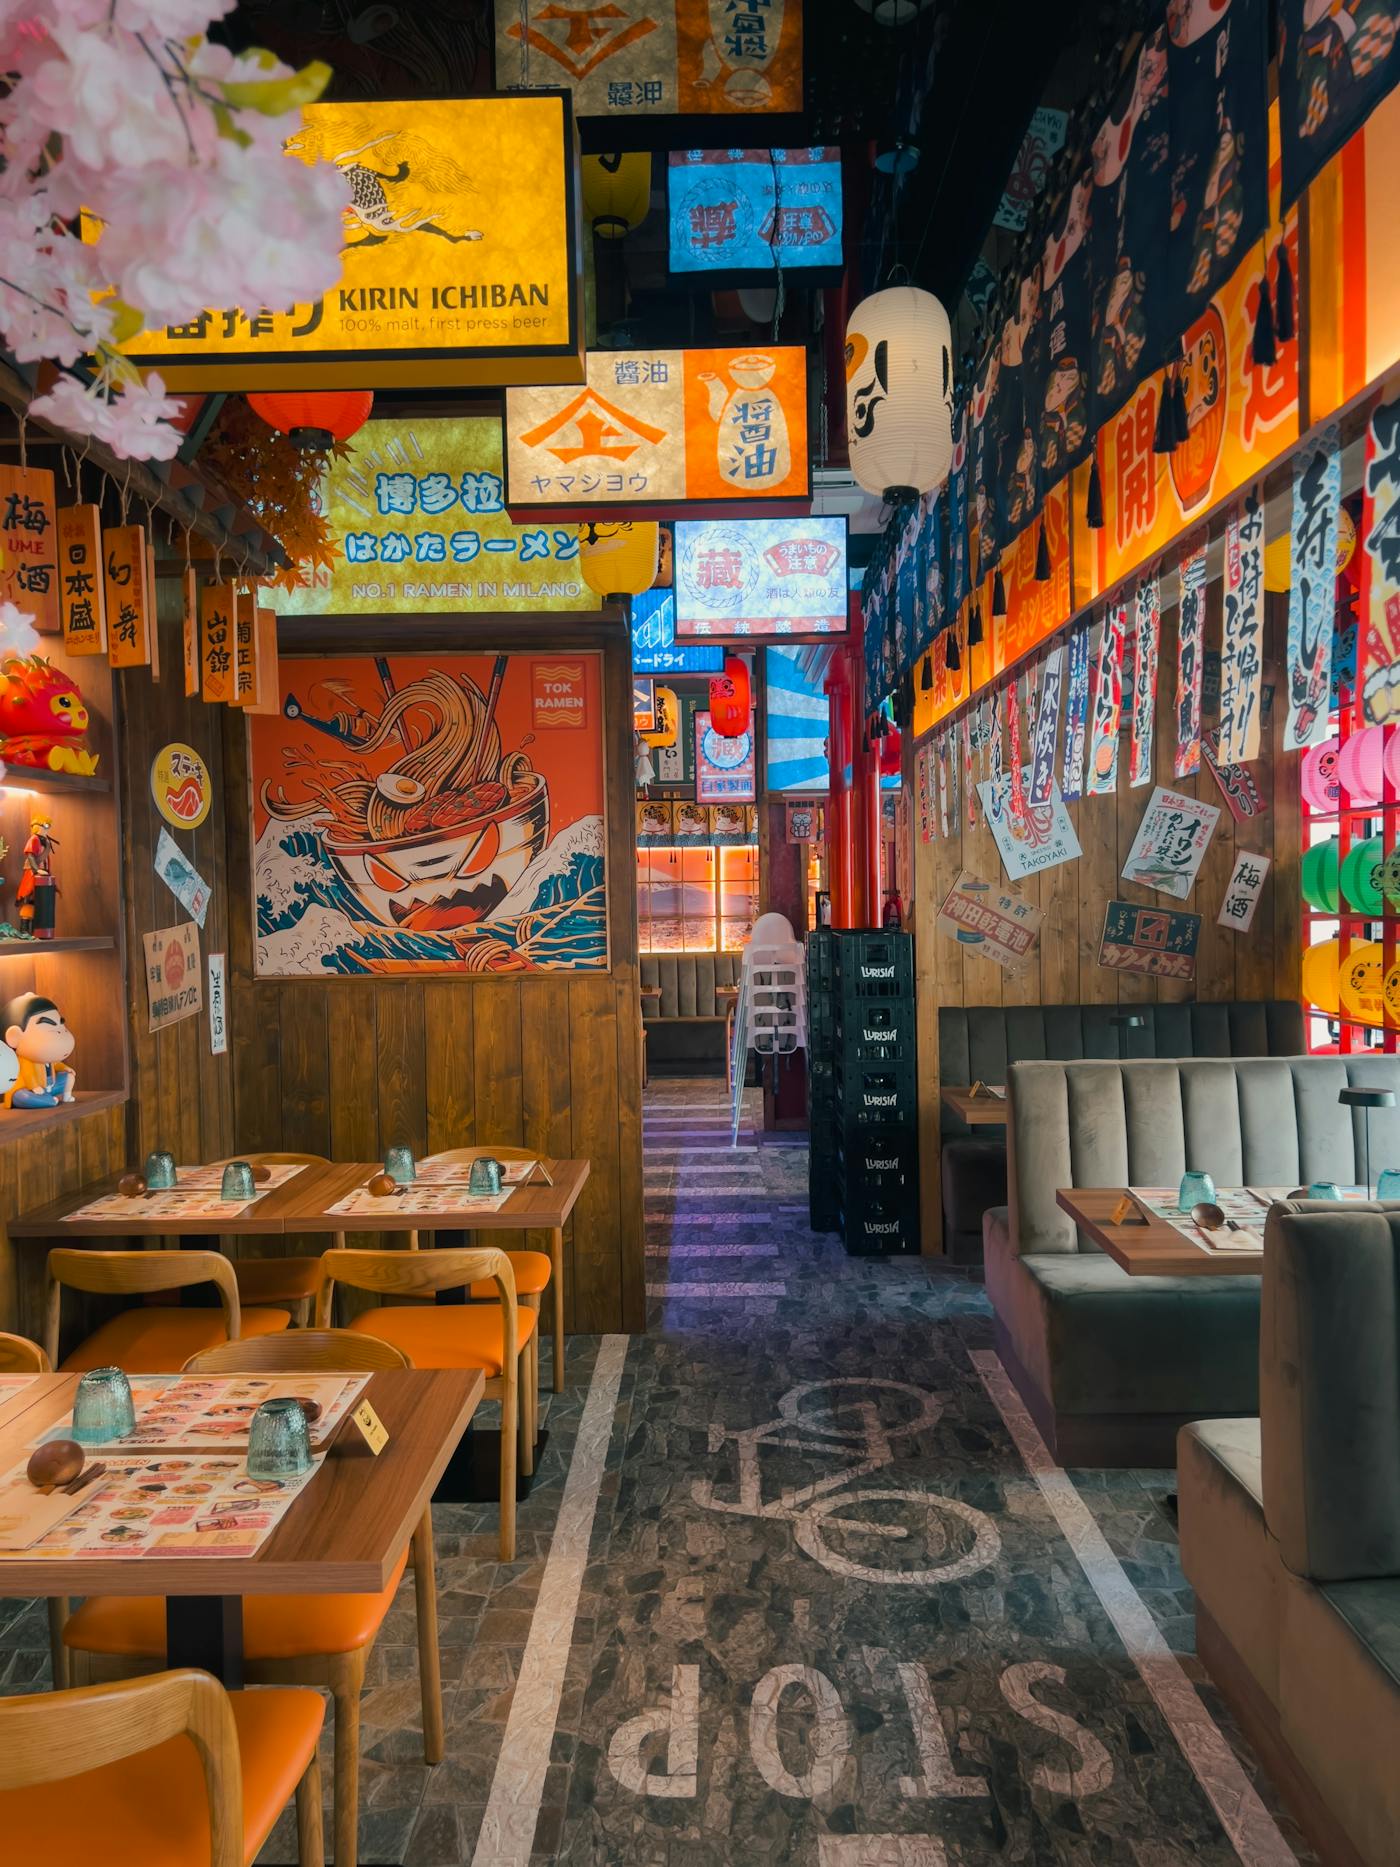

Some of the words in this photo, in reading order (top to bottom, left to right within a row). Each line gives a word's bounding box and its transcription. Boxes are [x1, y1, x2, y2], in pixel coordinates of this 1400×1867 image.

[338, 287, 419, 312] KIRIN
[432, 283, 550, 309] ICHIBAN
[338, 318, 382, 333] 100%
[386, 317, 426, 333] malt,
[429, 316, 462, 331] first
[465, 318, 509, 333] press
[8, 538, 46, 556] UME
[345, 530, 578, 563] はかたラーメン
[778, 543, 828, 558] うまいもの
[786, 556, 818, 571] 注意
[1297, 449, 1333, 671] 寿し
[64, 543, 97, 633] 日本盛
[351, 582, 396, 599] NO.1
[402, 582, 473, 599] RAMEN
[478, 582, 498, 598] IN
[503, 581, 581, 598] MILANO
[1236, 484, 1263, 758] お持ち帰り
[205, 609, 232, 680] 山田錦
[543, 683, 572, 694] TOK
[534, 696, 584, 709] RAMEN
[1036, 677, 1061, 801] 水炊き
[1170, 818, 1202, 866] イワシ
[1020, 847, 1069, 871] TAKOYAKI
[1226, 862, 1262, 920] 梅酒
[859, 965, 896, 980] LURISIA
[862, 1028, 898, 1043] LURISIA
[863, 1092, 898, 1107] LURISIA
[865, 1156, 900, 1171] LURISIA
[864, 1220, 901, 1235] LURISIA
[606, 1661, 1114, 1799] STOP
